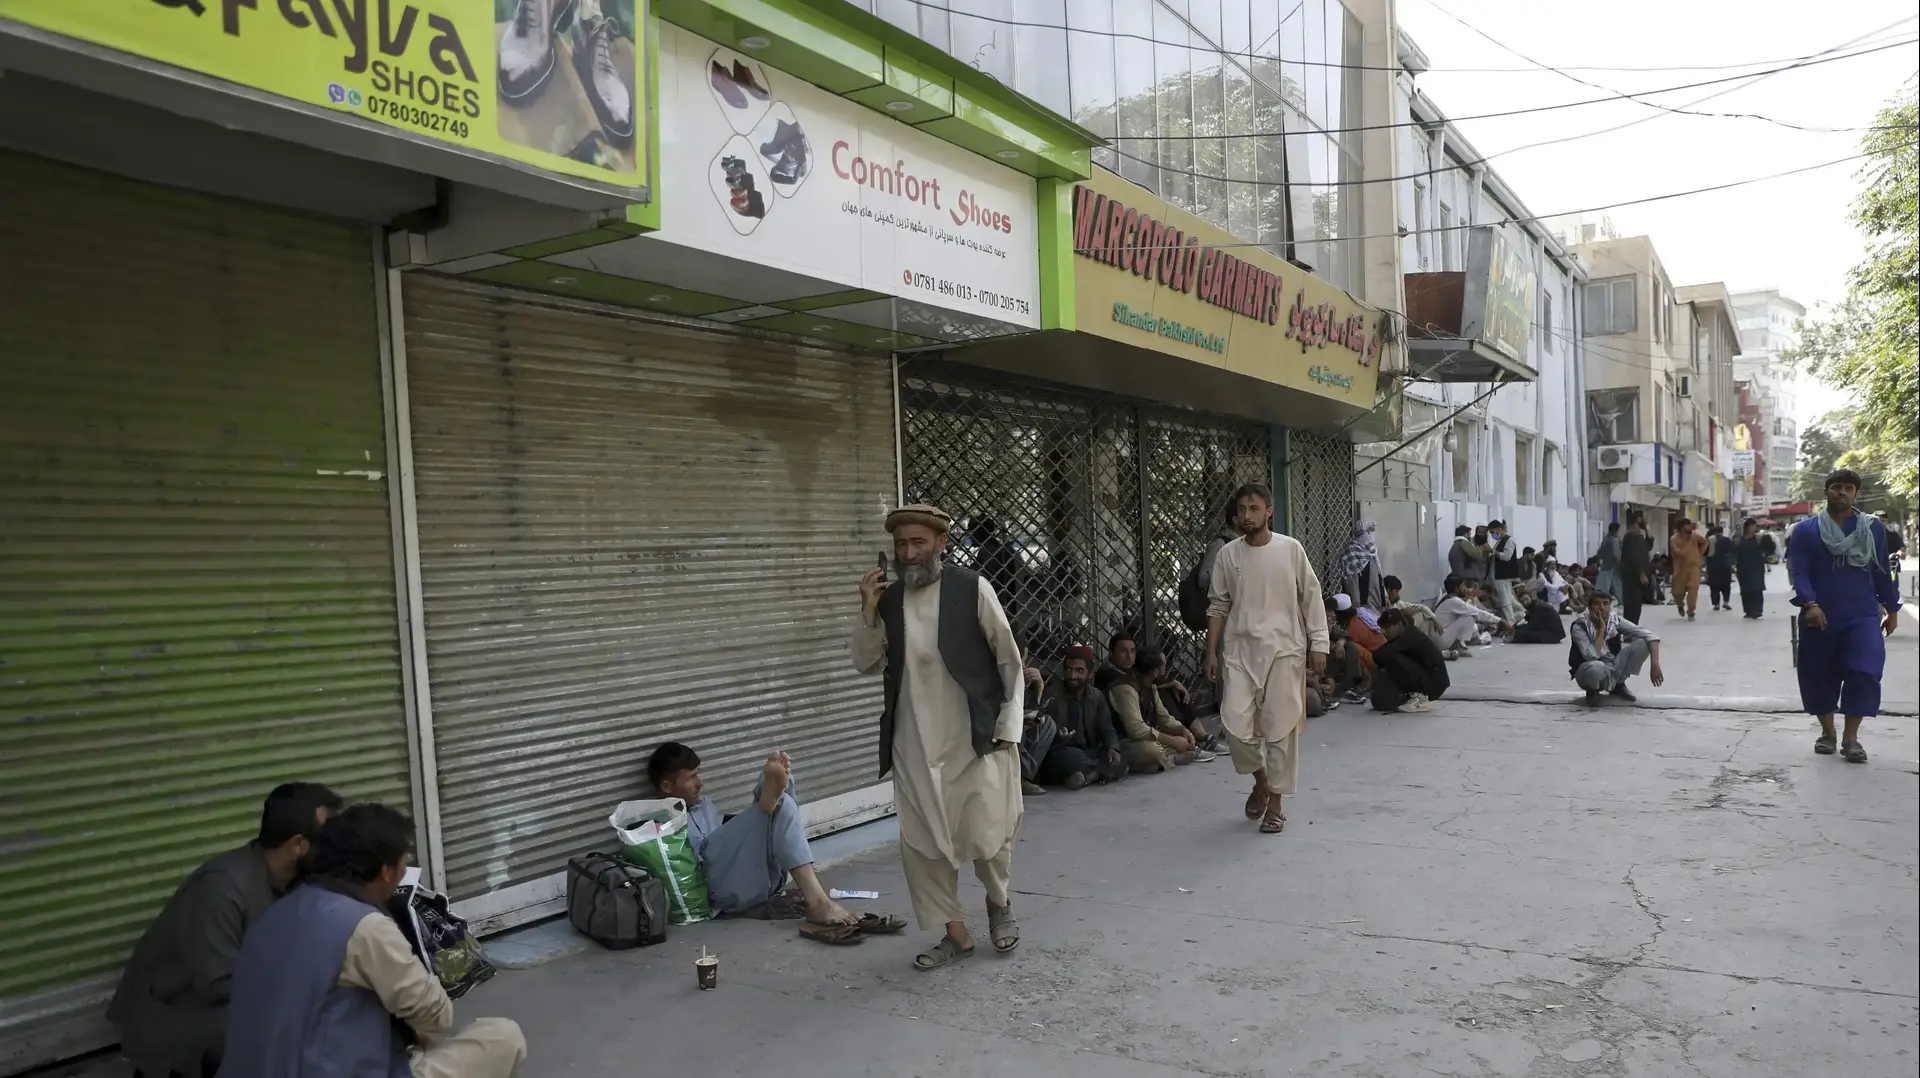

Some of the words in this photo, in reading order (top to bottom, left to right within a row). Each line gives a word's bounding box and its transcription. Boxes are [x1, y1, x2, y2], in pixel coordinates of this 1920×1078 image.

[367, 96, 469, 138] 0780302749
[371, 60, 481, 119] SHOES
[831, 140, 941, 210] Comfort
[950, 189, 1012, 234] Shoes
[1073, 184, 1199, 294] MARCOPOLO
[1198, 247, 1283, 326] GARMENTS
[913, 272, 936, 292] 0781
[938, 279, 954, 296] 486
[956, 283, 972, 300] 013
[979, 289, 999, 307] 0700
[1000, 295, 1015, 311] 205
[1016, 299, 1030, 315] 754
